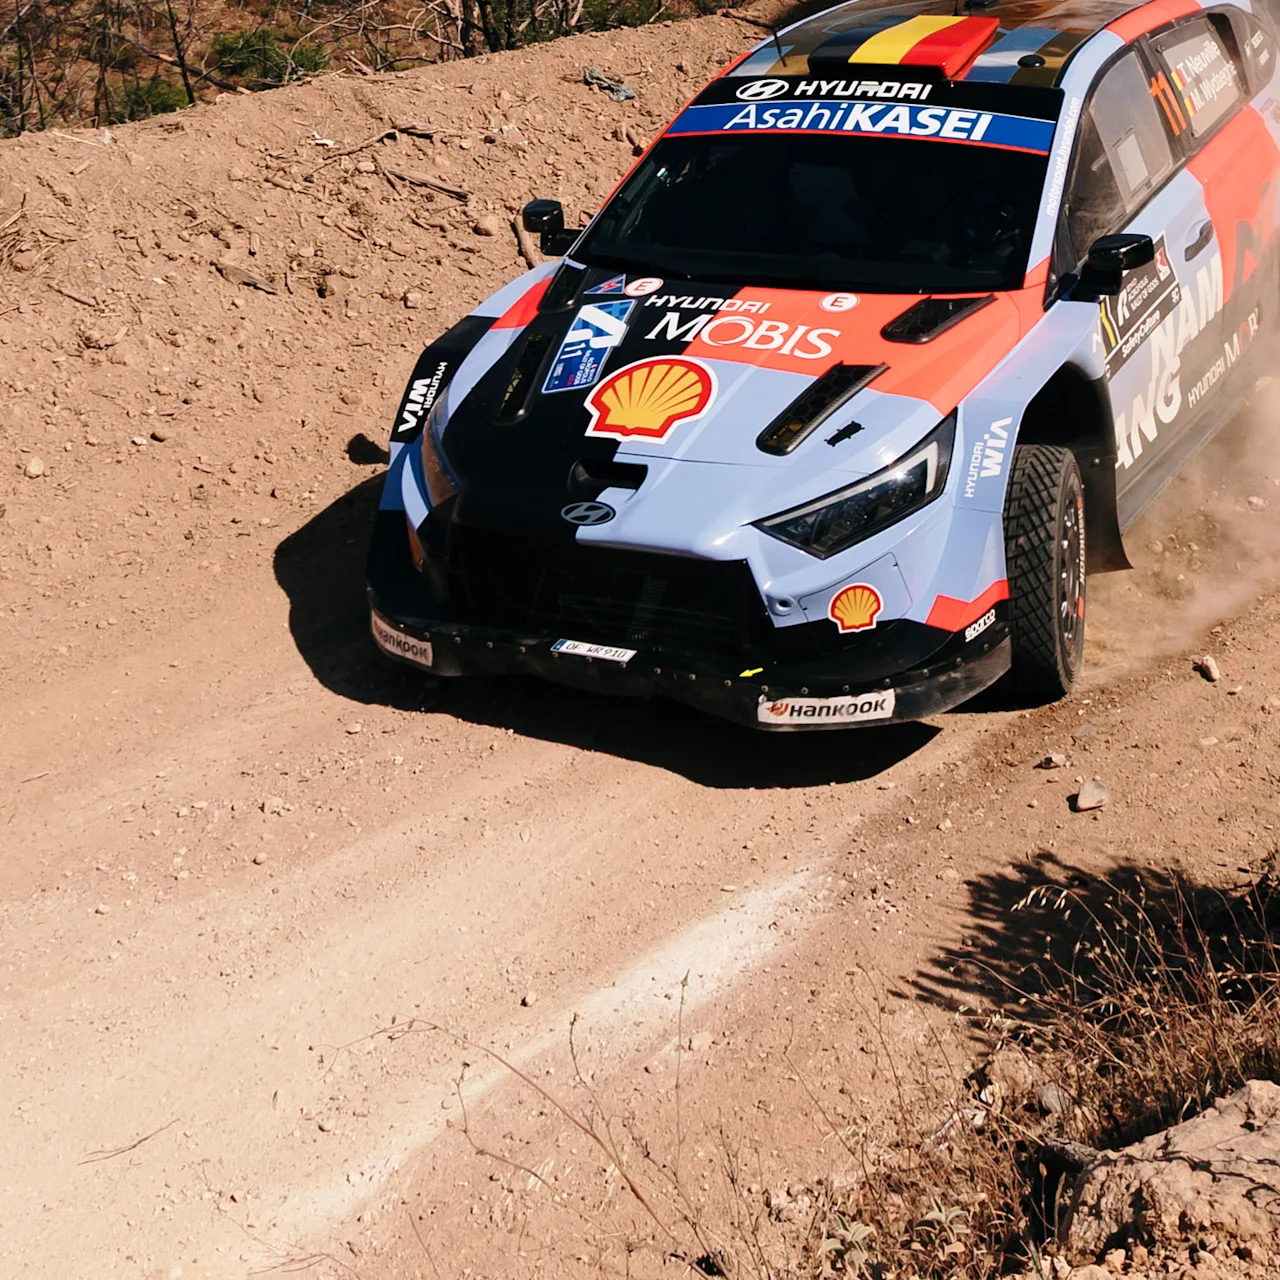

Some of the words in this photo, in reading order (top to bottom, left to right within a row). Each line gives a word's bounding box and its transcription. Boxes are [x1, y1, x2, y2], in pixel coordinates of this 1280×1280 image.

[1185, 40, 1220, 78] Neuville
[793, 80, 933, 100] HYUNDAI
[1150, 71, 1187, 136] 11
[634, 281, 653, 292] E
[831, 296, 851, 308] E
[644, 294, 771, 314] HYUNDAI
[560, 342, 586, 359] 11
[644, 311, 841, 360] MOBIS
[423, 362, 448, 408] HYUNDAI
[1187, 357, 1226, 408] HYUNDAI
[964, 441, 984, 498] HYUNDAI
[965, 608, 996, 639] sparco
